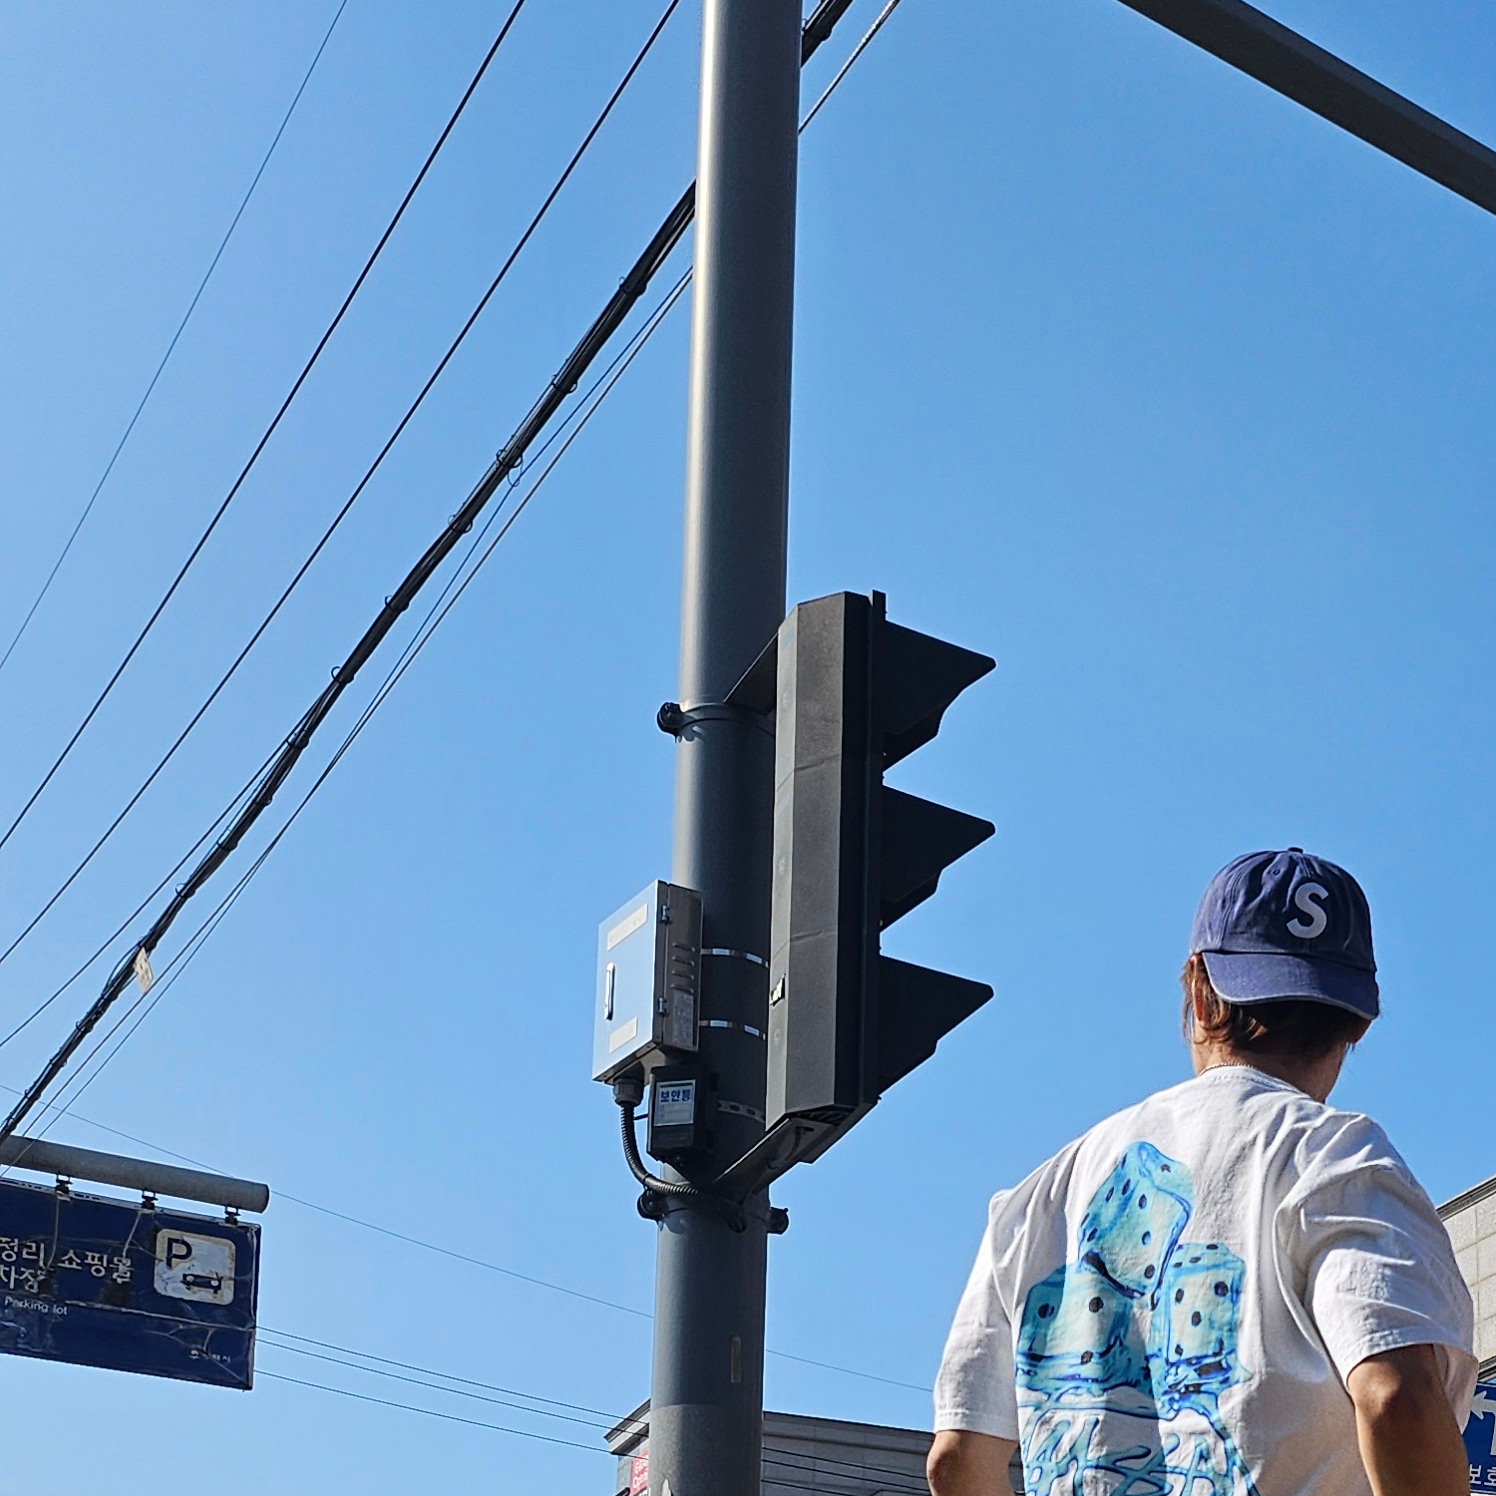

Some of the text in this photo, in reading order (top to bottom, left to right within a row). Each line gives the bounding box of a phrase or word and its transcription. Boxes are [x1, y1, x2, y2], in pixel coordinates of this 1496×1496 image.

[1286, 882, 1329, 939] S
[57, 1250, 134, 1285] 쇼핑몰
[4, 1296, 69, 1315] Parking lot
